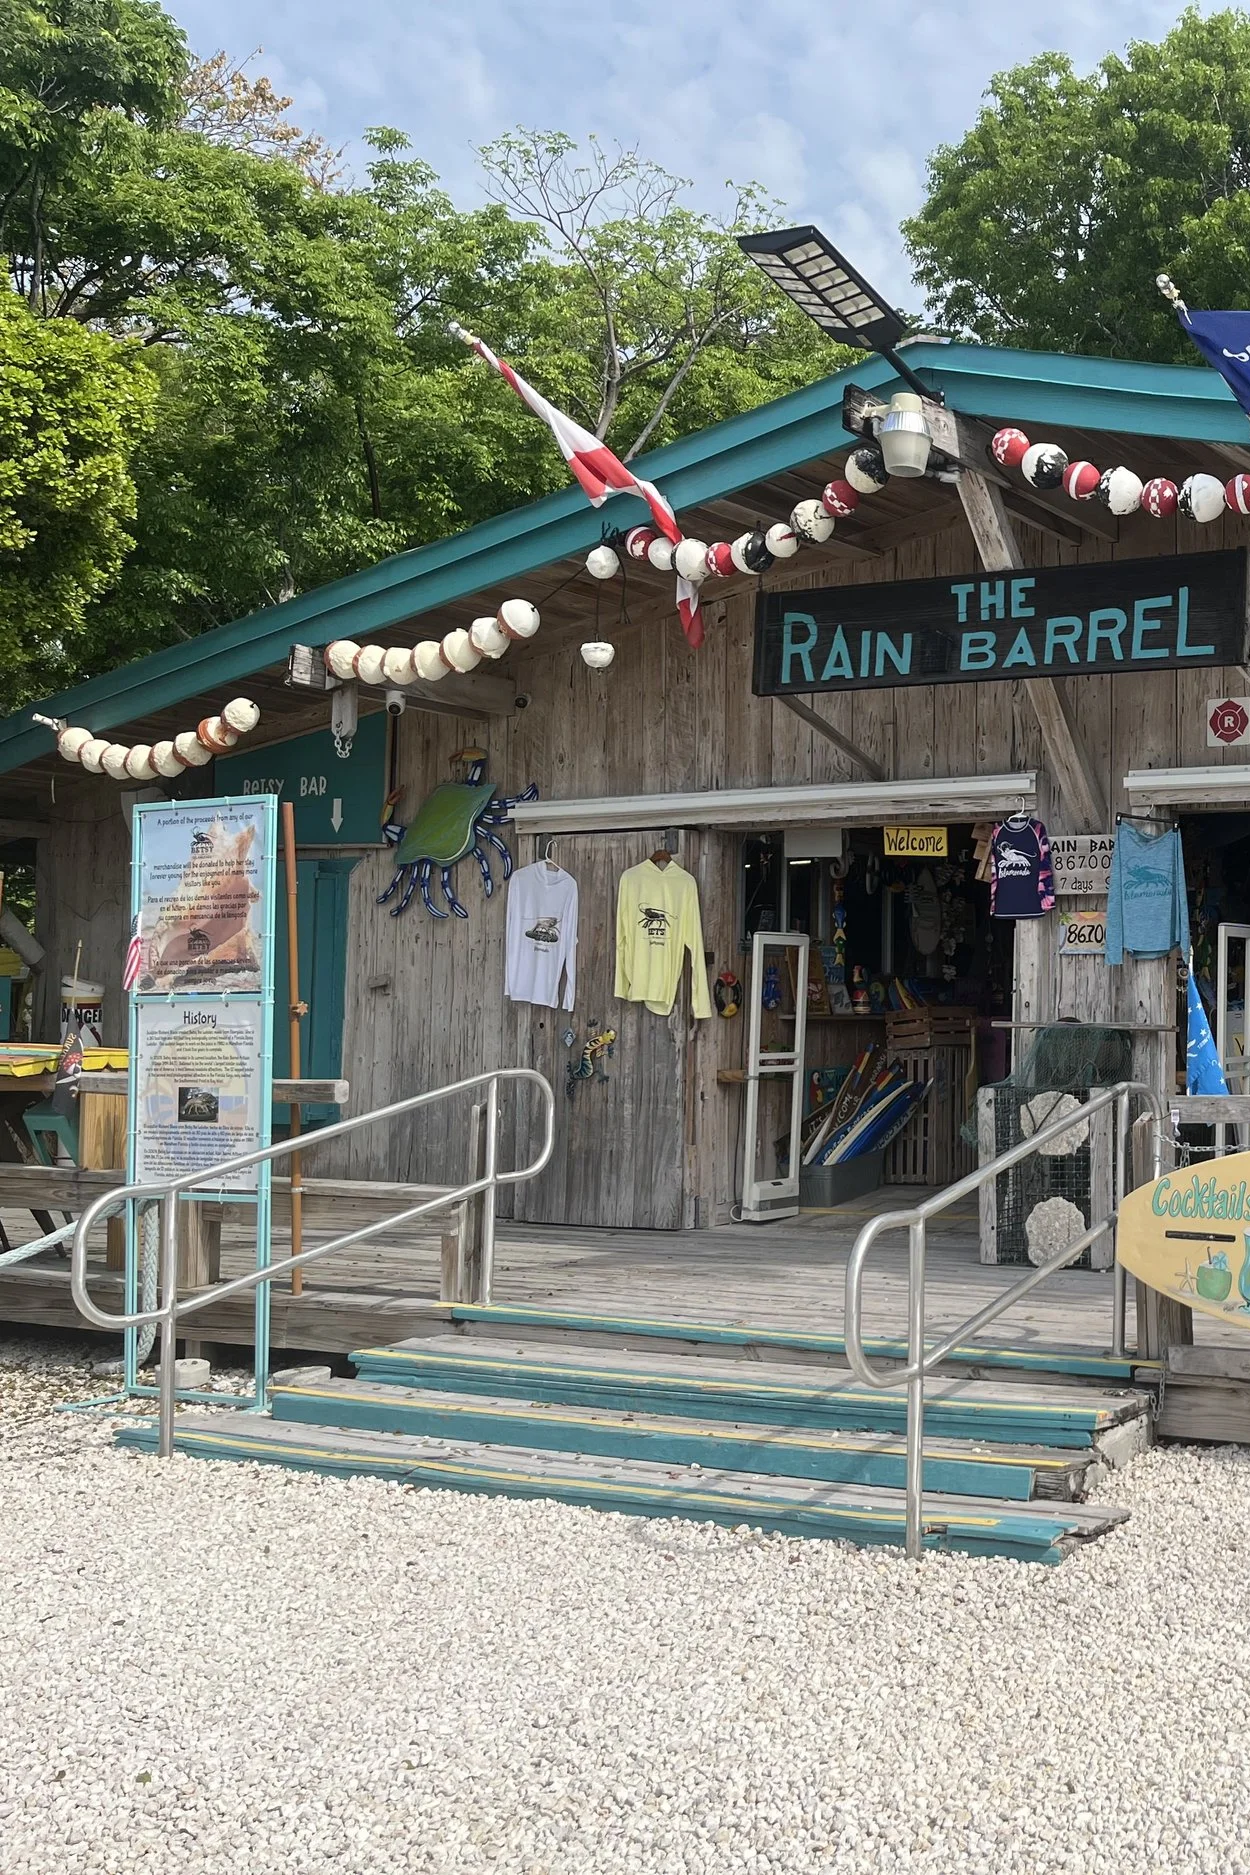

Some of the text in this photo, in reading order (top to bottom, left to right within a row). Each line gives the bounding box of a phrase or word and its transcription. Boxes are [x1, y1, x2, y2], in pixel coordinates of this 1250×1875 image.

[950, 577, 1036, 623] THE
[780, 586, 1216, 684] RAIN BARREL
[1224, 716, 1235, 728] R
[300, 776, 327, 797] BAR
[886, 828, 944, 852] Welcome
[1050, 840, 1077, 853] AIN
[1060, 878, 1067, 890] 7
[1071, 877, 1094, 893] days
[1067, 924, 1106, 943] 8670
[183, 1010, 217, 1028] History
